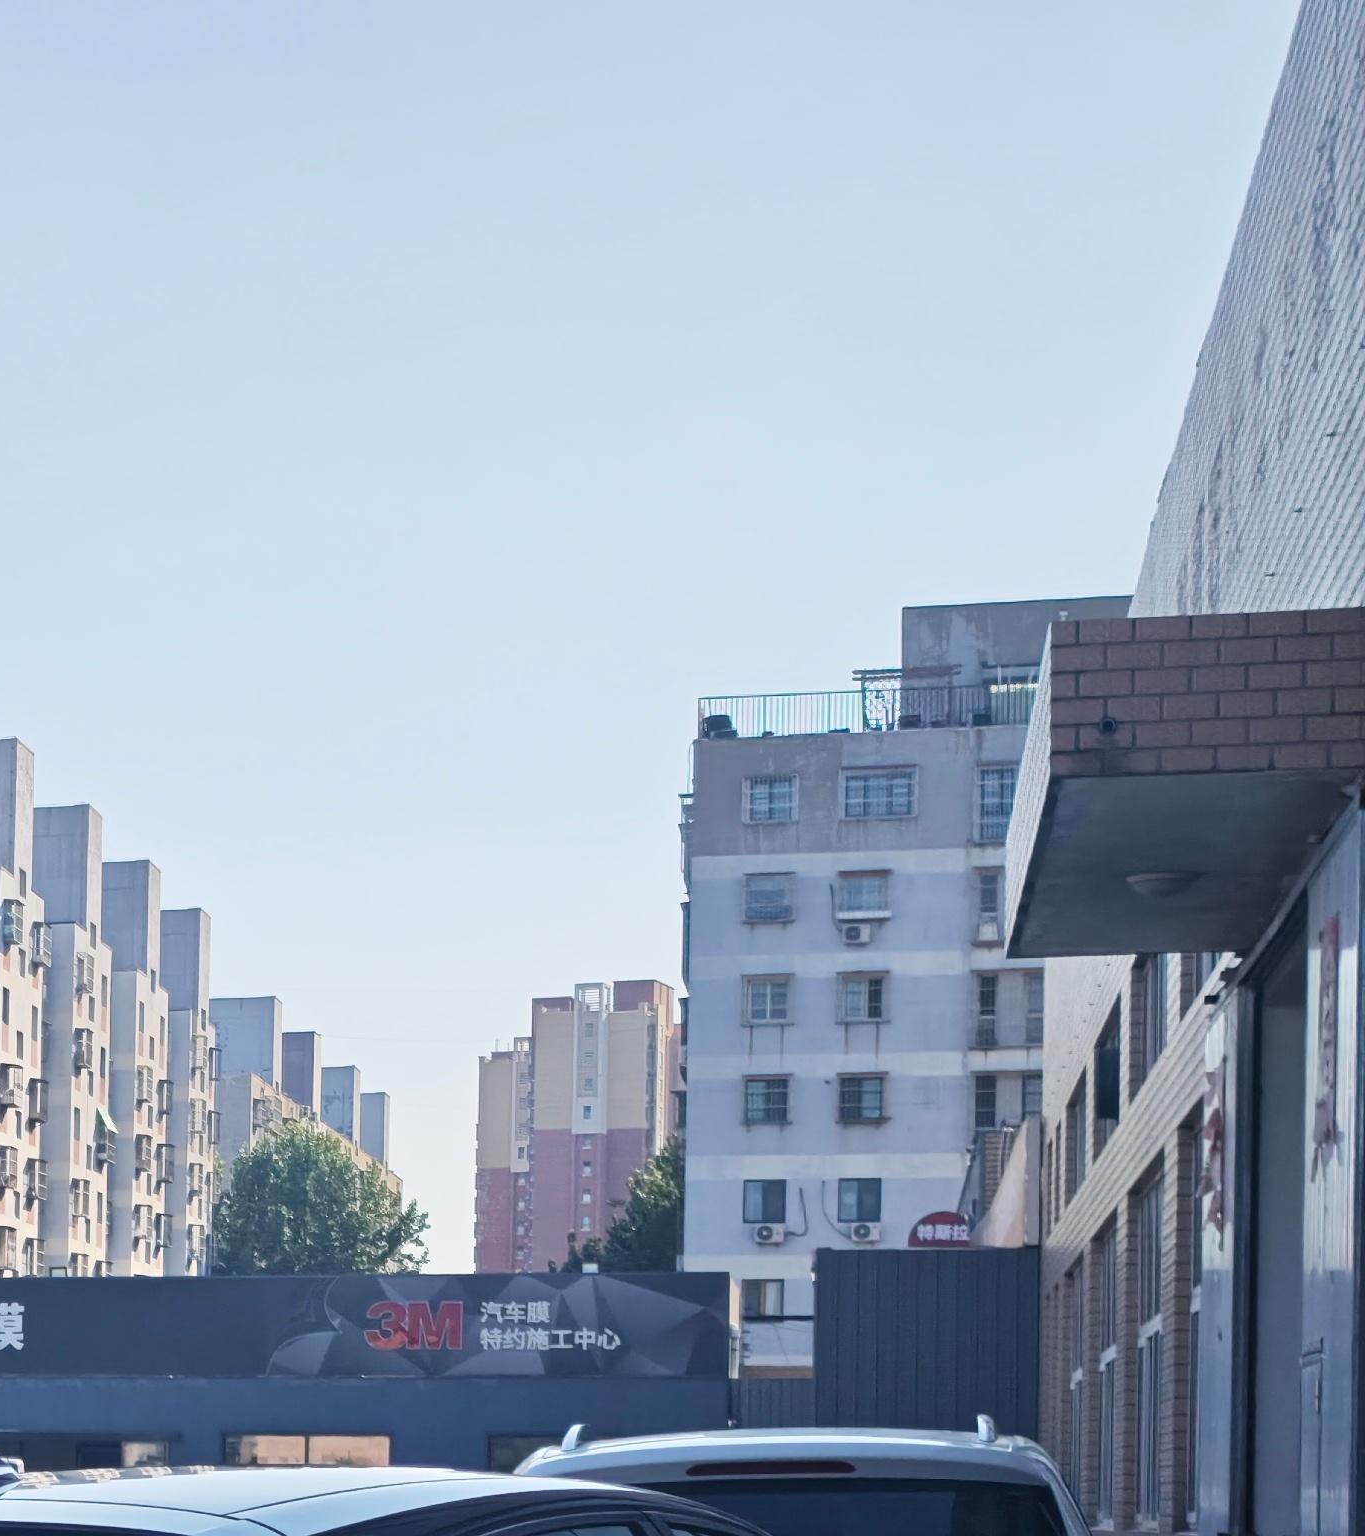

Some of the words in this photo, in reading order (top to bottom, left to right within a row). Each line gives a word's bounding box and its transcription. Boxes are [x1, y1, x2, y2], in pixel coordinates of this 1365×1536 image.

[479, 1300, 551, 1324] 汽车膜
[364, 1301, 463, 1350] 3M
[479, 1327, 622, 1351] 特约施工中心
